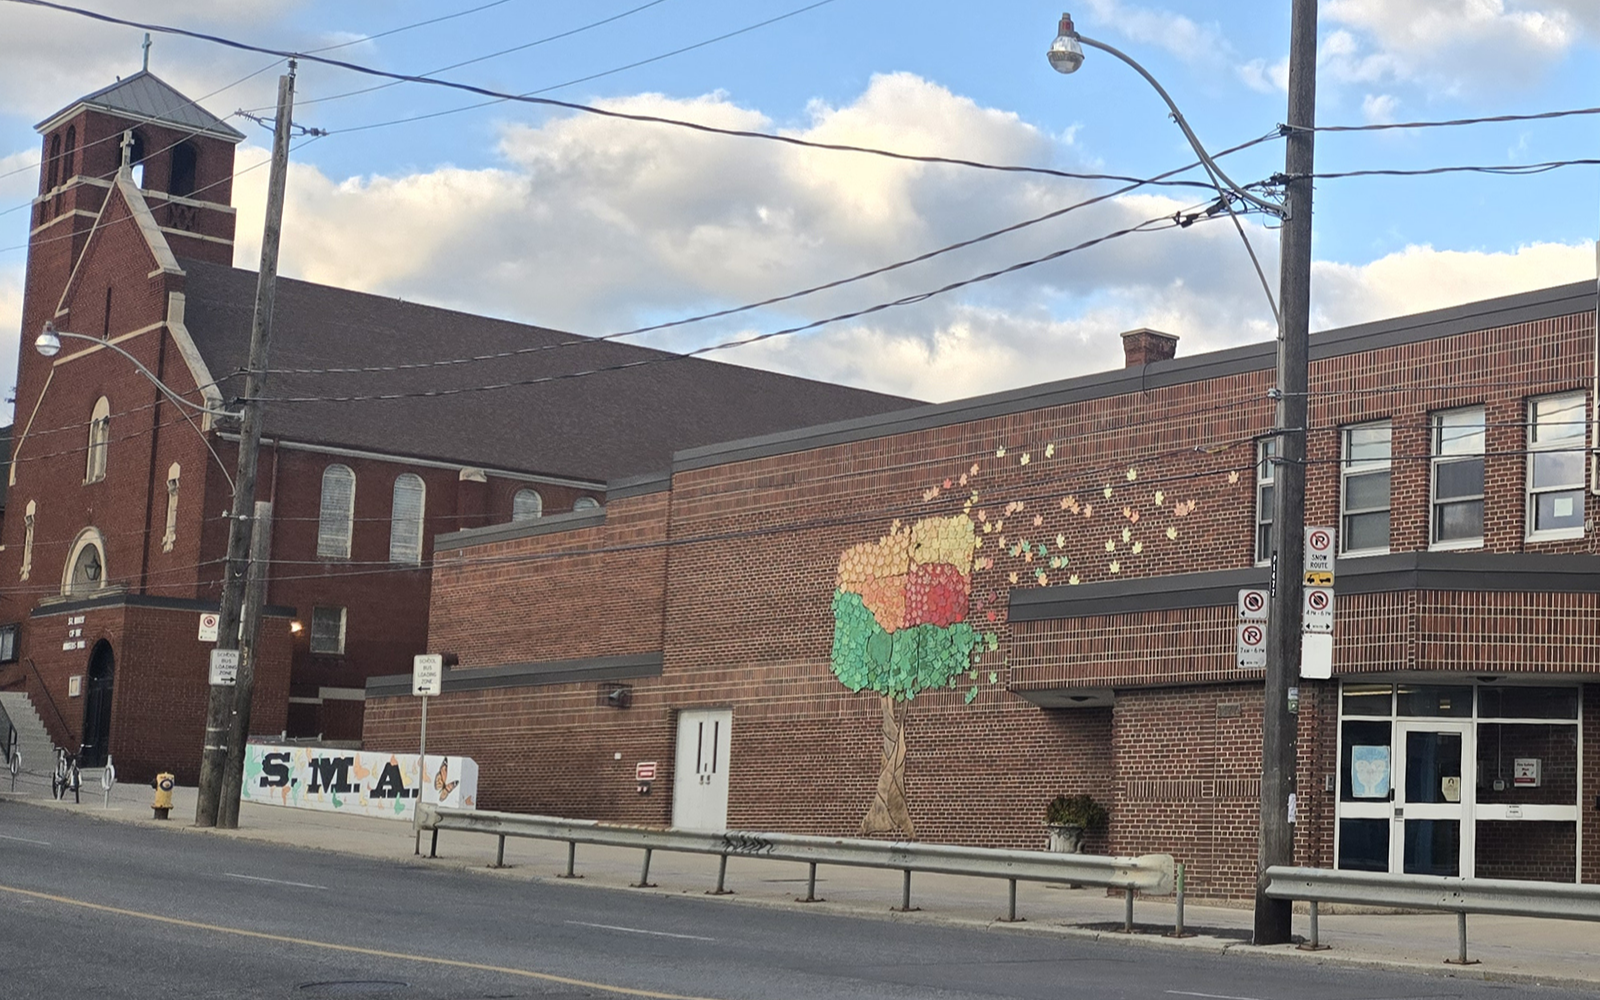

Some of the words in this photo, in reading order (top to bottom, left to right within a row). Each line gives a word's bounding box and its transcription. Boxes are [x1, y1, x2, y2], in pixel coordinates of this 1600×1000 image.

[1311, 553, 1328, 561] SNOW
[1310, 561, 1328, 569] ROUTE
[260, 752, 297, 787] S.
[307, 757, 360, 793] M.
[370, 762, 419, 798] A.
